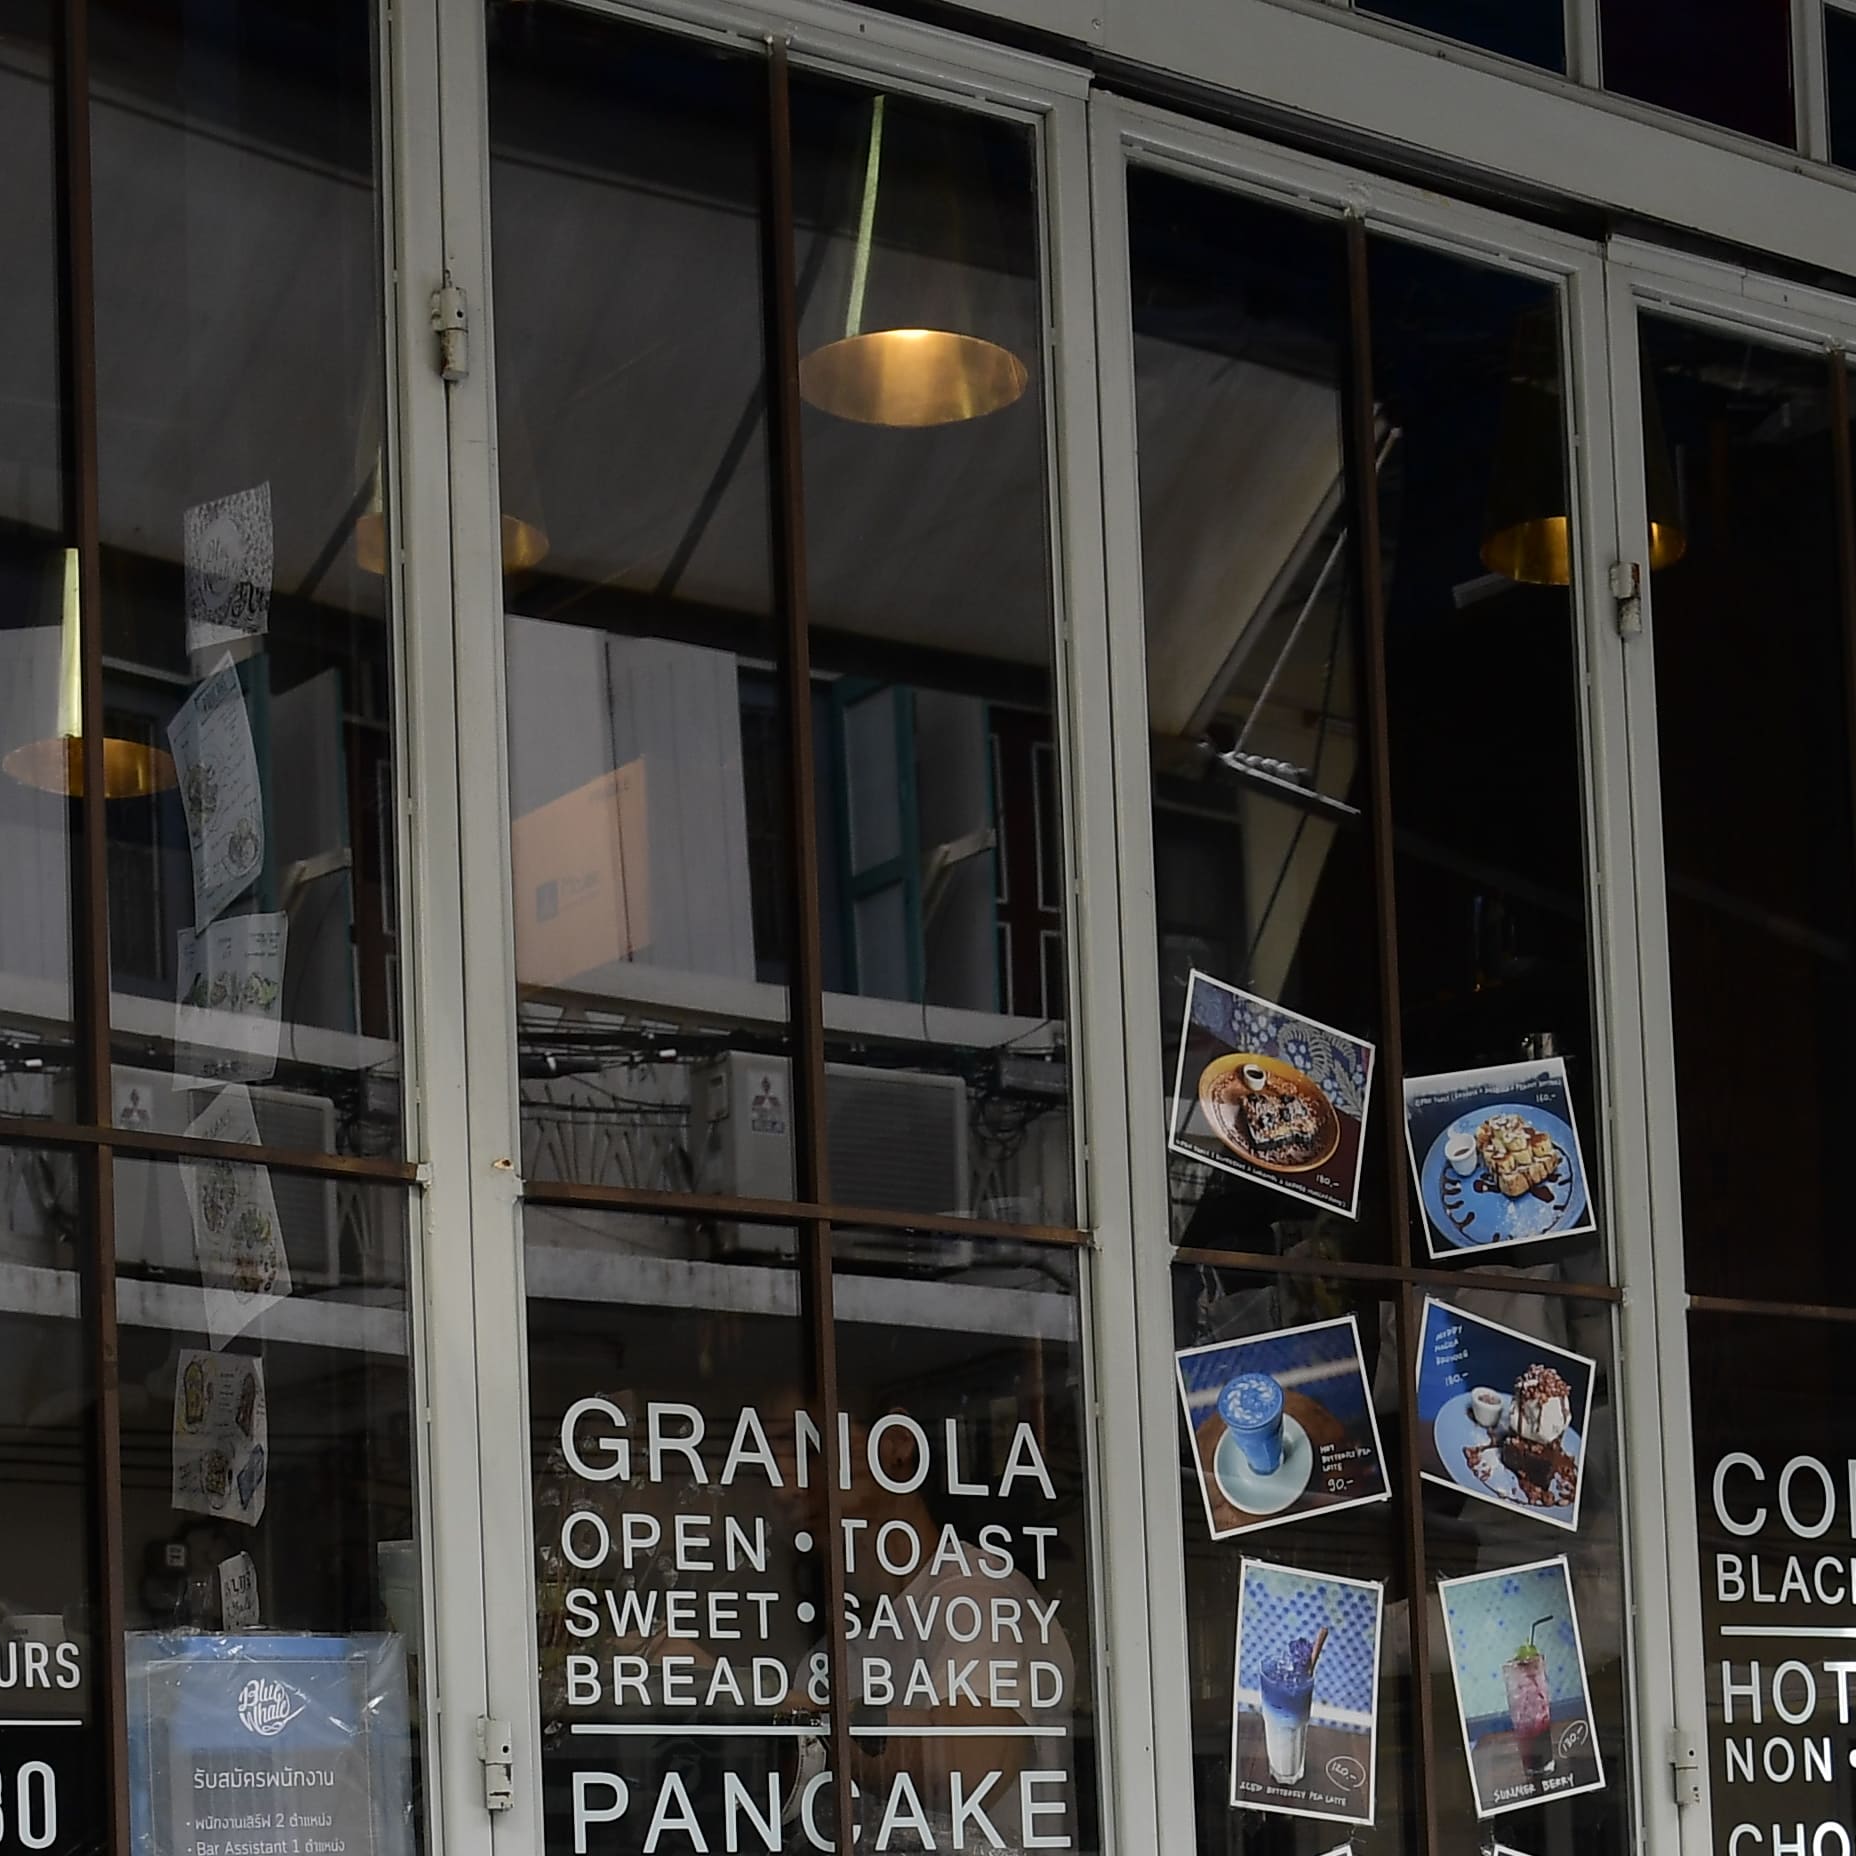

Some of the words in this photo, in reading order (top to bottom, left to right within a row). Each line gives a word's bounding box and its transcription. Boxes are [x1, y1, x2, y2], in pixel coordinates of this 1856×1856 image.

[560, 1397, 1058, 1500] GRANOLA
[1327, 1478, 1354, 1492] 90.-
[561, 1510, 768, 1575] OPEN
[841, 1517, 1059, 1582] TOAST
[565, 1588, 780, 1641] SWEET
[844, 1595, 1063, 1647] SAVORY
[239, 1678, 286, 1711] Blue
[567, 1655, 790, 1709] BREAD
[807, 1652, 832, 1707] &
[862, 1656, 1066, 1710] BAKED
[239, 1699, 291, 1733] Whale
[1726, 1736, 1834, 1785] NON
[194, 1766, 335, 1790] รับสมัครพนักงาน
[1493, 1783, 1537, 1803] SUMMER
[1541, 1772, 1575, 1792] BERRY
[276, 1814, 285, 1828] 2
[572, 1769, 1072, 1856] PANCAKE
[196, 1841, 220, 1856] Bar
[225, 1840, 288, 1856] Assistant
[292, 1840, 300, 1854] 1
